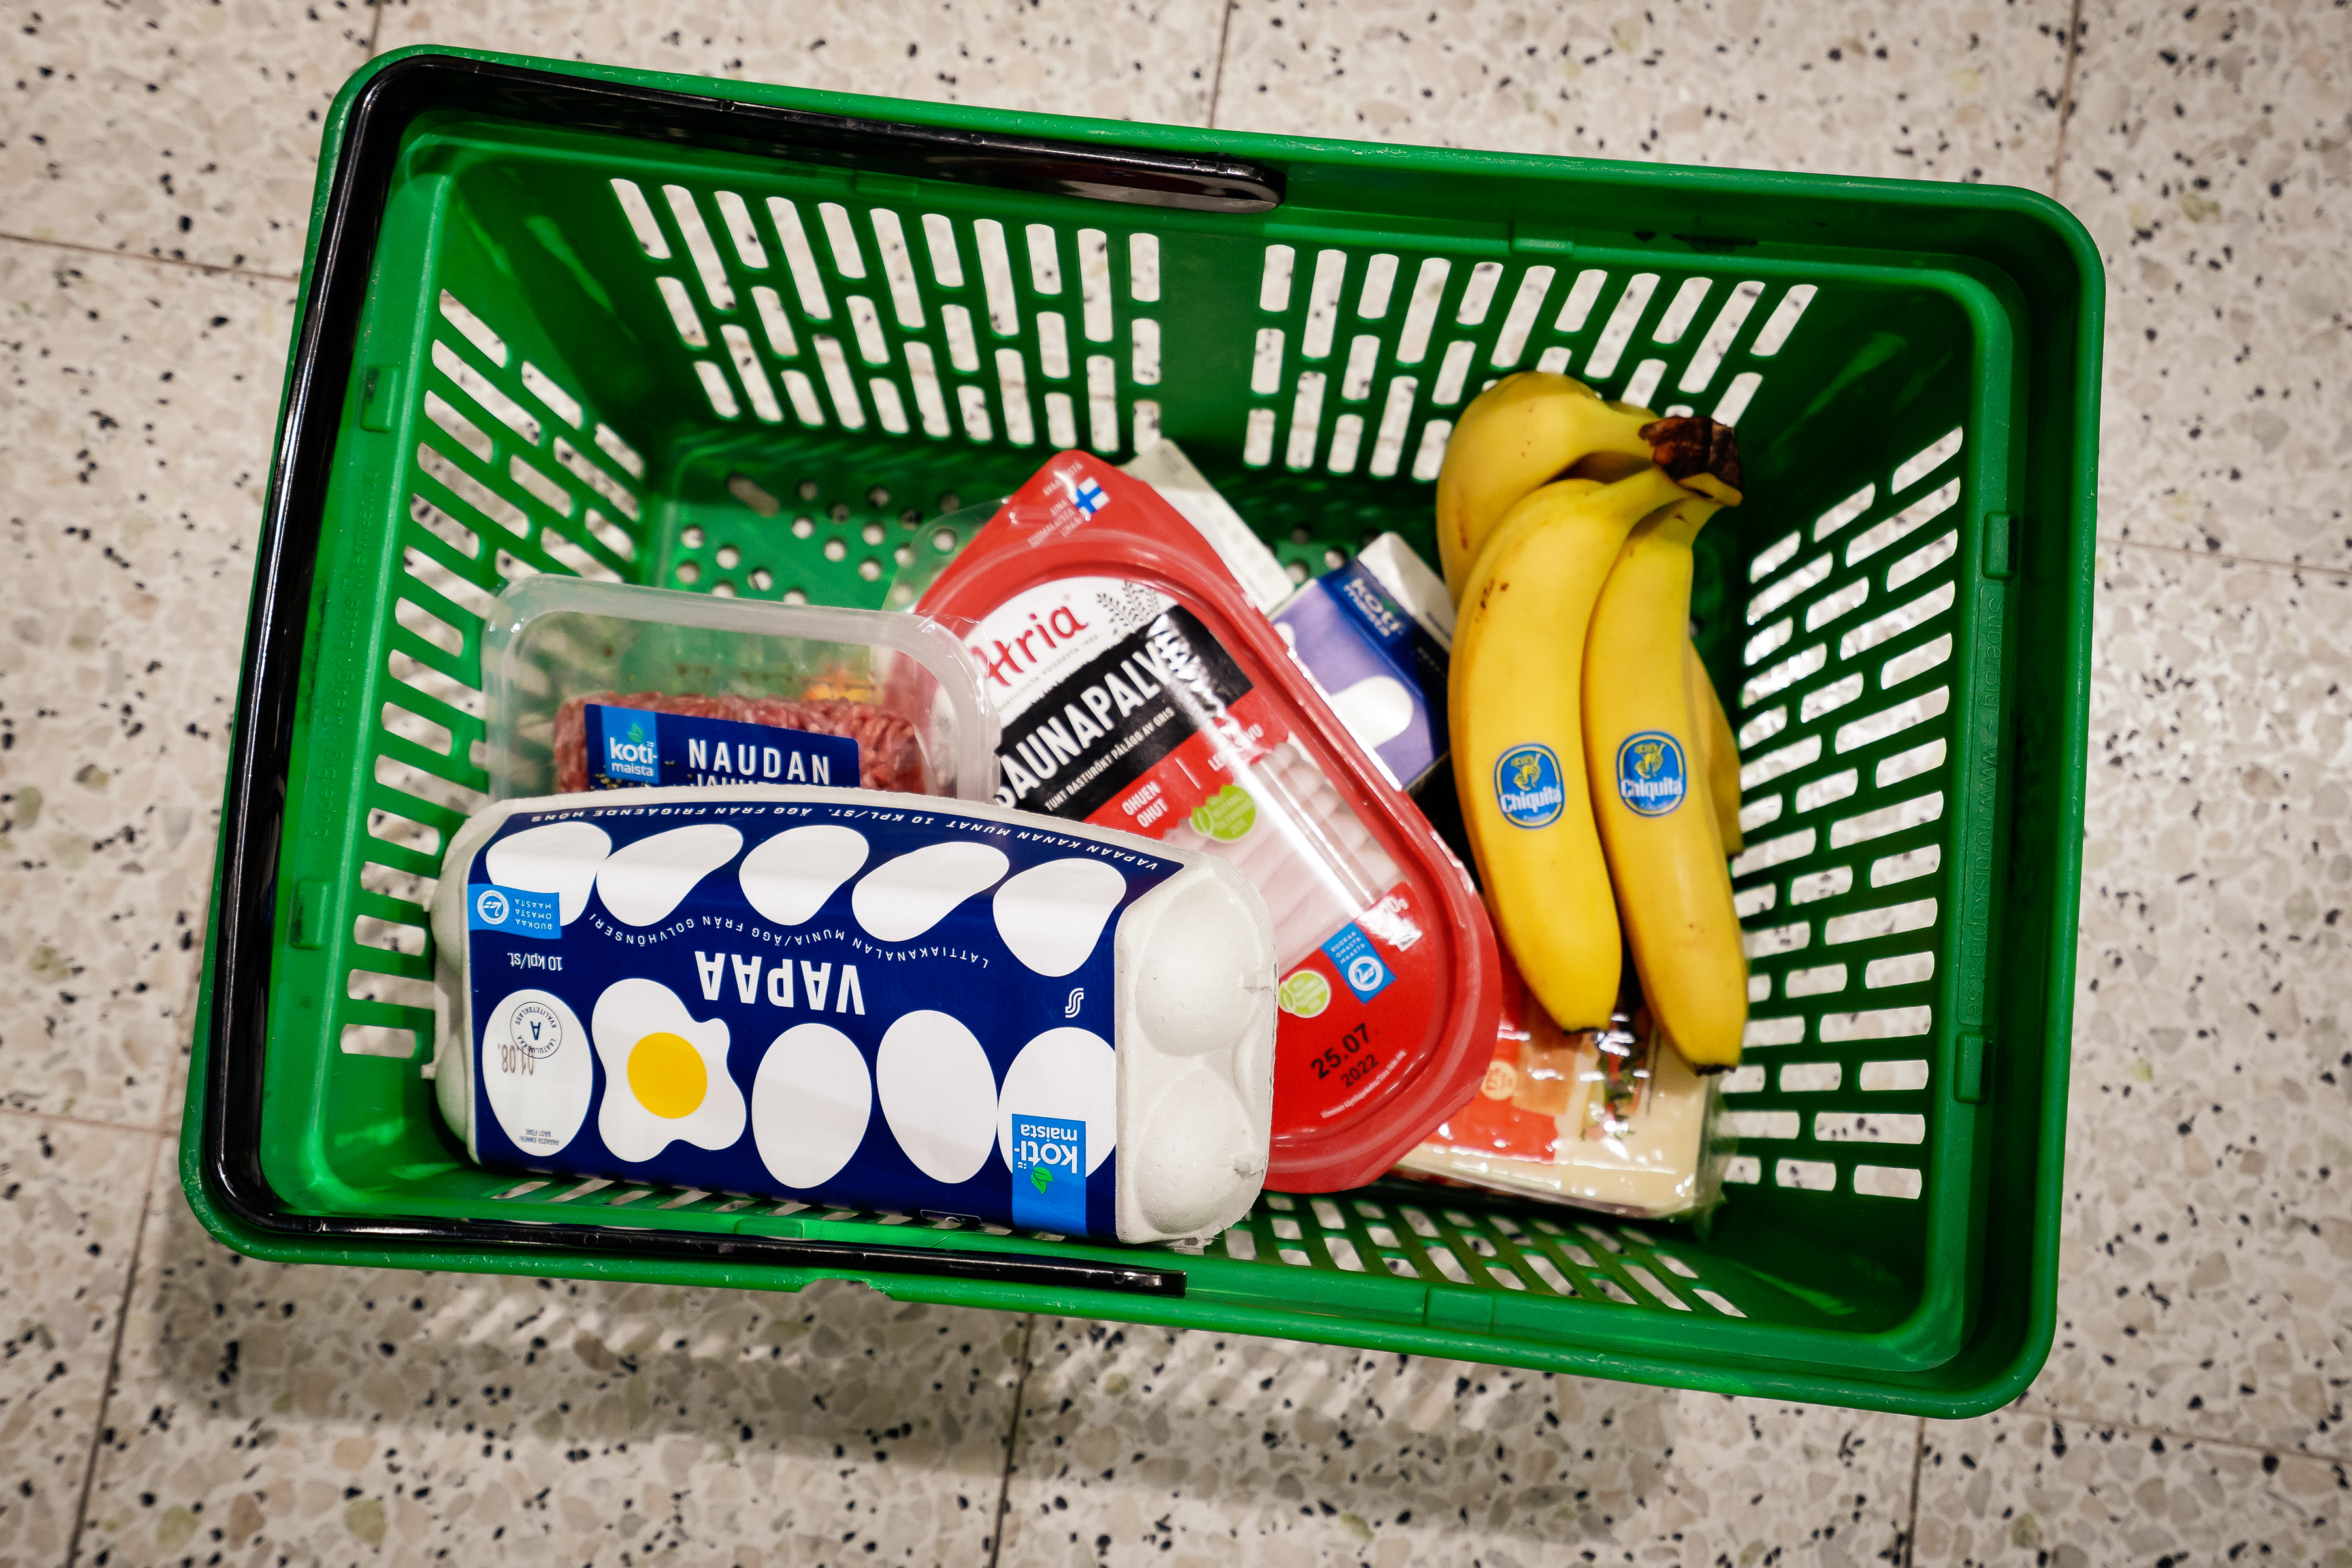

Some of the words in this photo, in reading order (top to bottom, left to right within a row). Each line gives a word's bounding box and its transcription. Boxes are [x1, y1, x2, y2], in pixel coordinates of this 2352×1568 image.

[1978, 597, 2003, 708] SuperBig
[993, 629, 1178, 808] AUNAPALV
[612, 761, 654, 777] maista
[688, 738, 831, 785] NAUDAN
[1045, 789, 1068, 811] TUNT
[1141, 721, 1156, 738] AV
[1121, 780, 1162, 817] OHUEN
[1499, 783, 1563, 813] Chiquita
[1620, 776, 1684, 802] Chiquita
[529, 809, 585, 823] HÖNS
[591, 806, 707, 818] FRIGÅENDE
[713, 806, 766, 817] FRÅN
[772, 806, 813, 817] ÄGG
[827, 808, 904, 823] KPL/ST.
[911, 815, 934, 825] 10
[1136, 797, 1169, 828] OHUT
[945, 820, 1011, 836] MUNAT
[1017, 830, 1081, 849] KANAN
[1085, 843, 1159, 870] VAPAAN
[1966, 746, 1997, 1017] www.nordiskaplast.se
[514, 897, 551, 910] MAASTA
[514, 907, 552, 920] OMASTA
[514, 917, 552, 930] RUOKAA
[587, 912, 694, 947] GOLVHÖNSERI
[701, 915, 744, 934] FRÅN
[750, 926, 845, 947] MUNIA/ÄGG
[506, 951, 546, 970] kpl/st.
[851, 937, 989, 969] LATTIAKANALAN
[547, 955, 563, 972] 10
[694, 950, 866, 1016] VAPAA
[514, 1005, 557, 1029] KVALITETSKLASS
[529, 1020, 542, 1041] A
[516, 1034, 557, 1054] LAATULUOKKA
[1340, 1053, 1380, 1088] 2022
[524, 1128, 538, 1137] FÖRE
[536, 1136, 559, 1146] PARASTA
[538, 1130, 551, 1138] BÄST
[1019, 1123, 1078, 1142] maista
[1013, 1139, 1078, 1174] koti-
